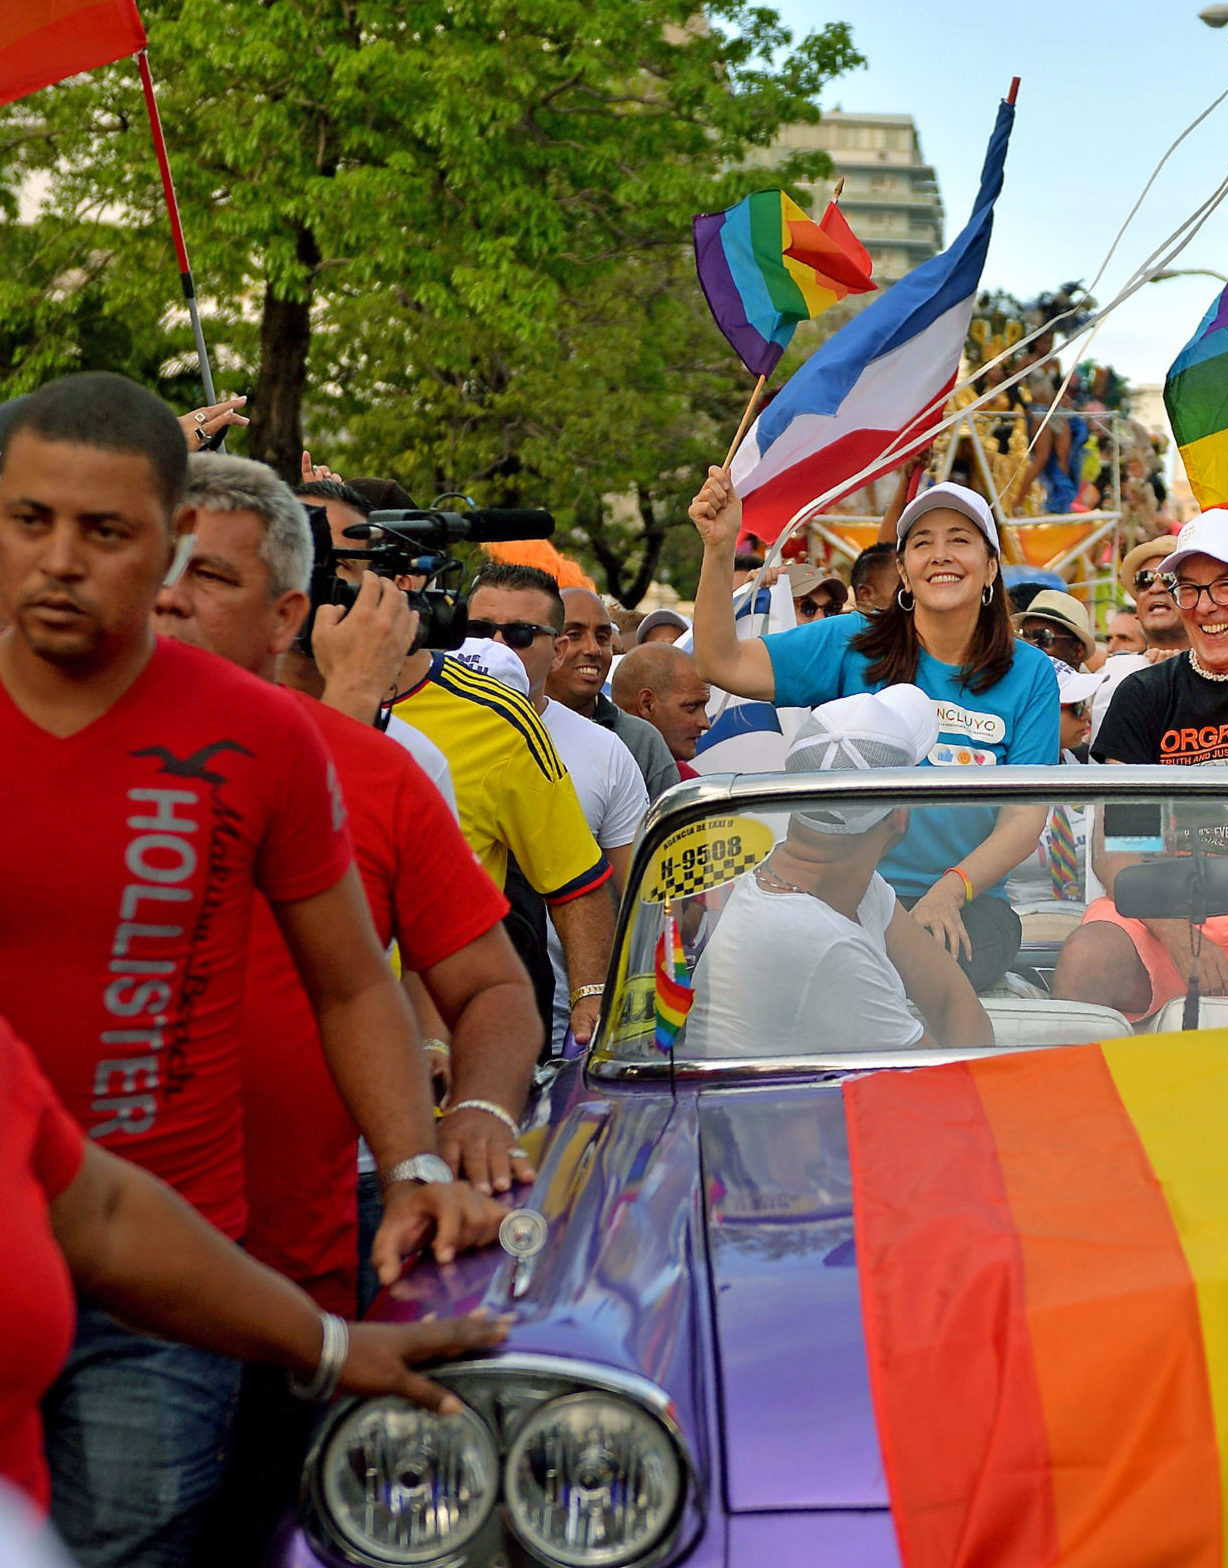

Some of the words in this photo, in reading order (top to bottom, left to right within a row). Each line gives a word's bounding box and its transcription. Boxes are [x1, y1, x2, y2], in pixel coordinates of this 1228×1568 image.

[936, 708, 996, 731] NCLUYO
[1192, 752, 1211, 764] AND
[663, 827, 695, 850] AGENCIA
[696, 823, 706, 833] DE
[661, 835, 742, 881] H-9508
[89, 787, 198, 1139] HOLLISTER
